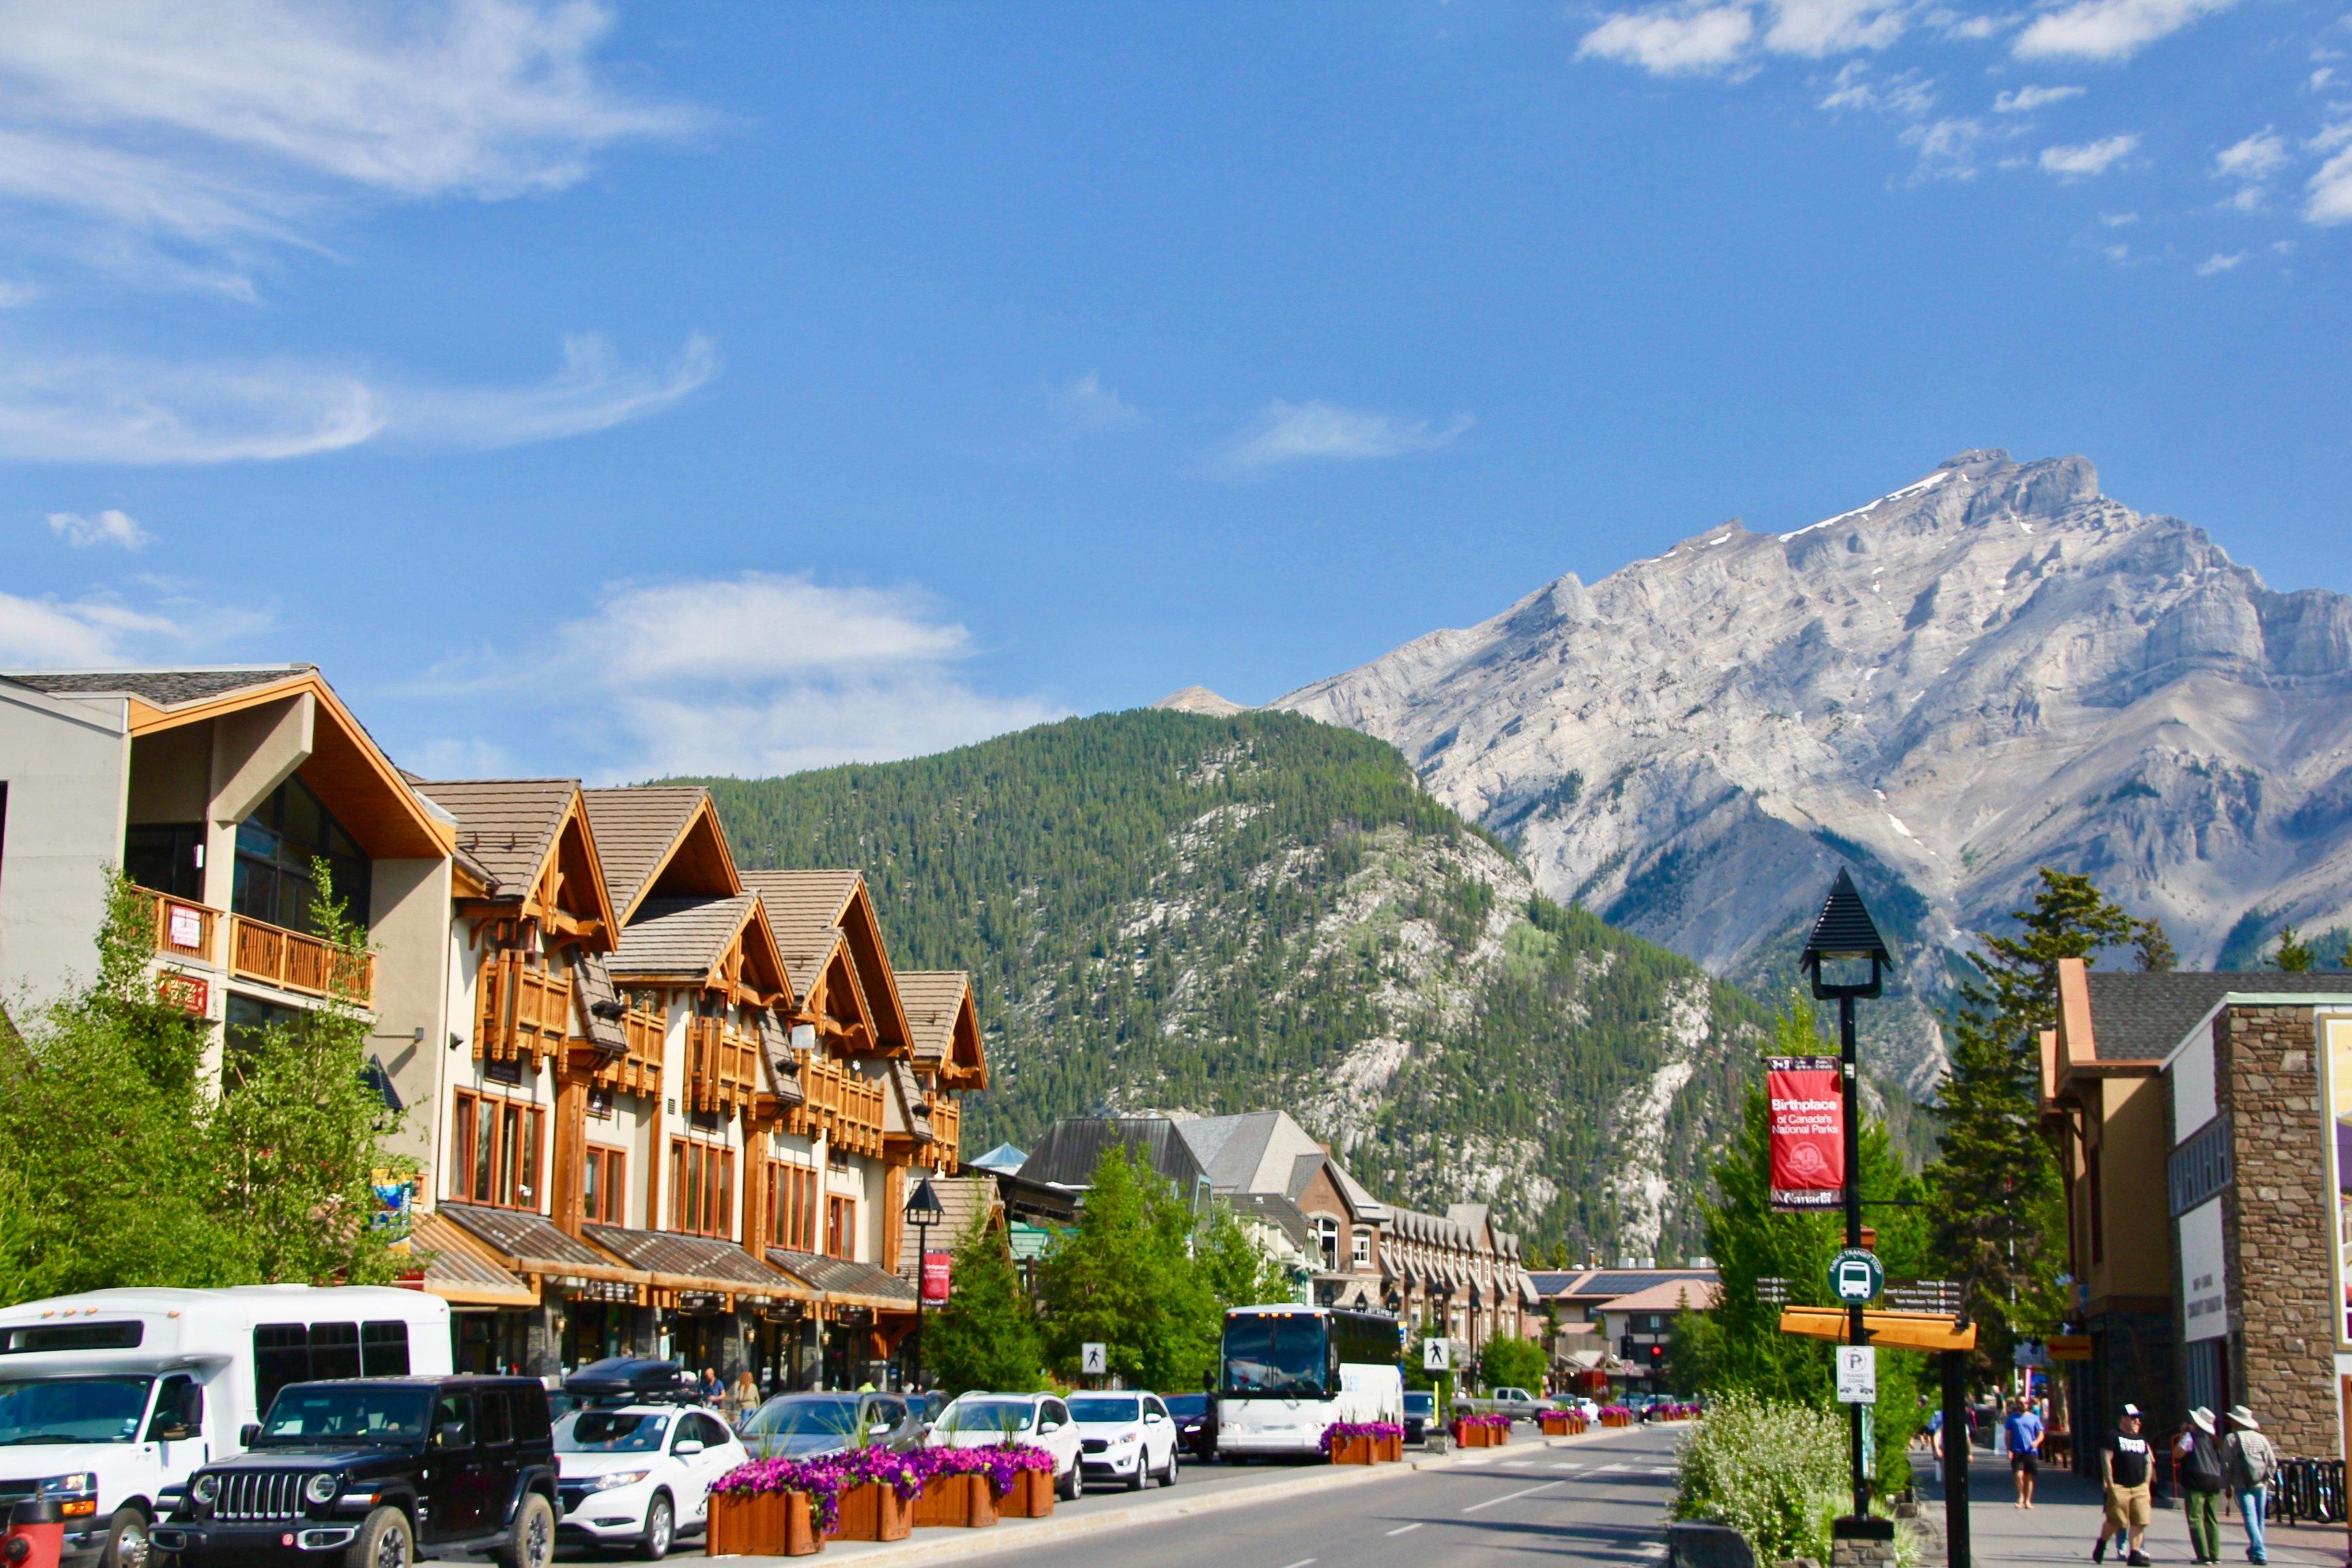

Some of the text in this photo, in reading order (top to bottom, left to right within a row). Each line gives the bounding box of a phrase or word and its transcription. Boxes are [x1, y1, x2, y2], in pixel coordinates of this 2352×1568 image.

[1771, 1098, 1838, 1113] Birthplace
[1777, 1114, 1833, 1124] of Canada's
[1771, 1124, 1838, 1134] National Parks
[1784, 1192, 1831, 1205] Canada
[1829, 1250, 1881, 1275] PUBLIC TRANSIT STOP
